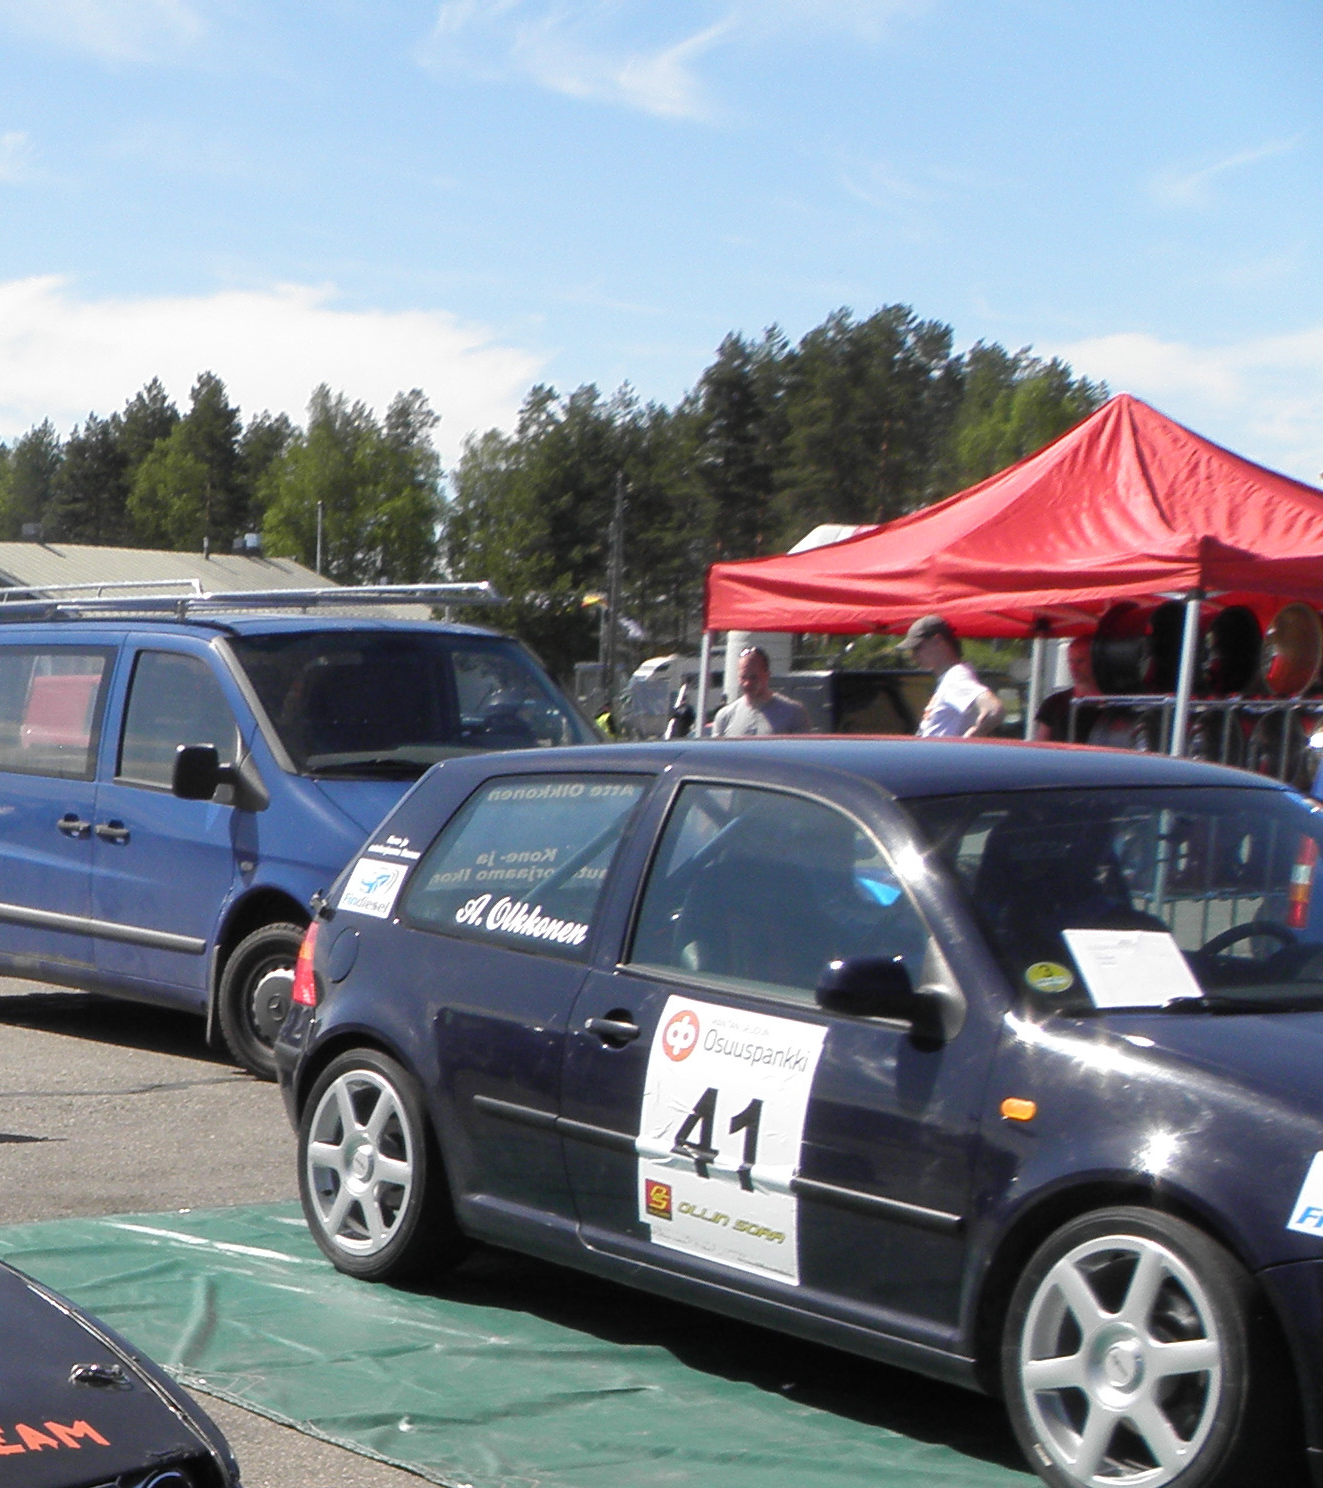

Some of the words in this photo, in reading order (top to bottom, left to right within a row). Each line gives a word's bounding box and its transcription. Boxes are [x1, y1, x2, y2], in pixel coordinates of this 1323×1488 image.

[703, 1028, 811, 1072] Osuuspankki
[670, 1086, 764, 1194] 41
[676, 1200, 730, 1227] OLLIN
[732, 1218, 787, 1245] SORA
